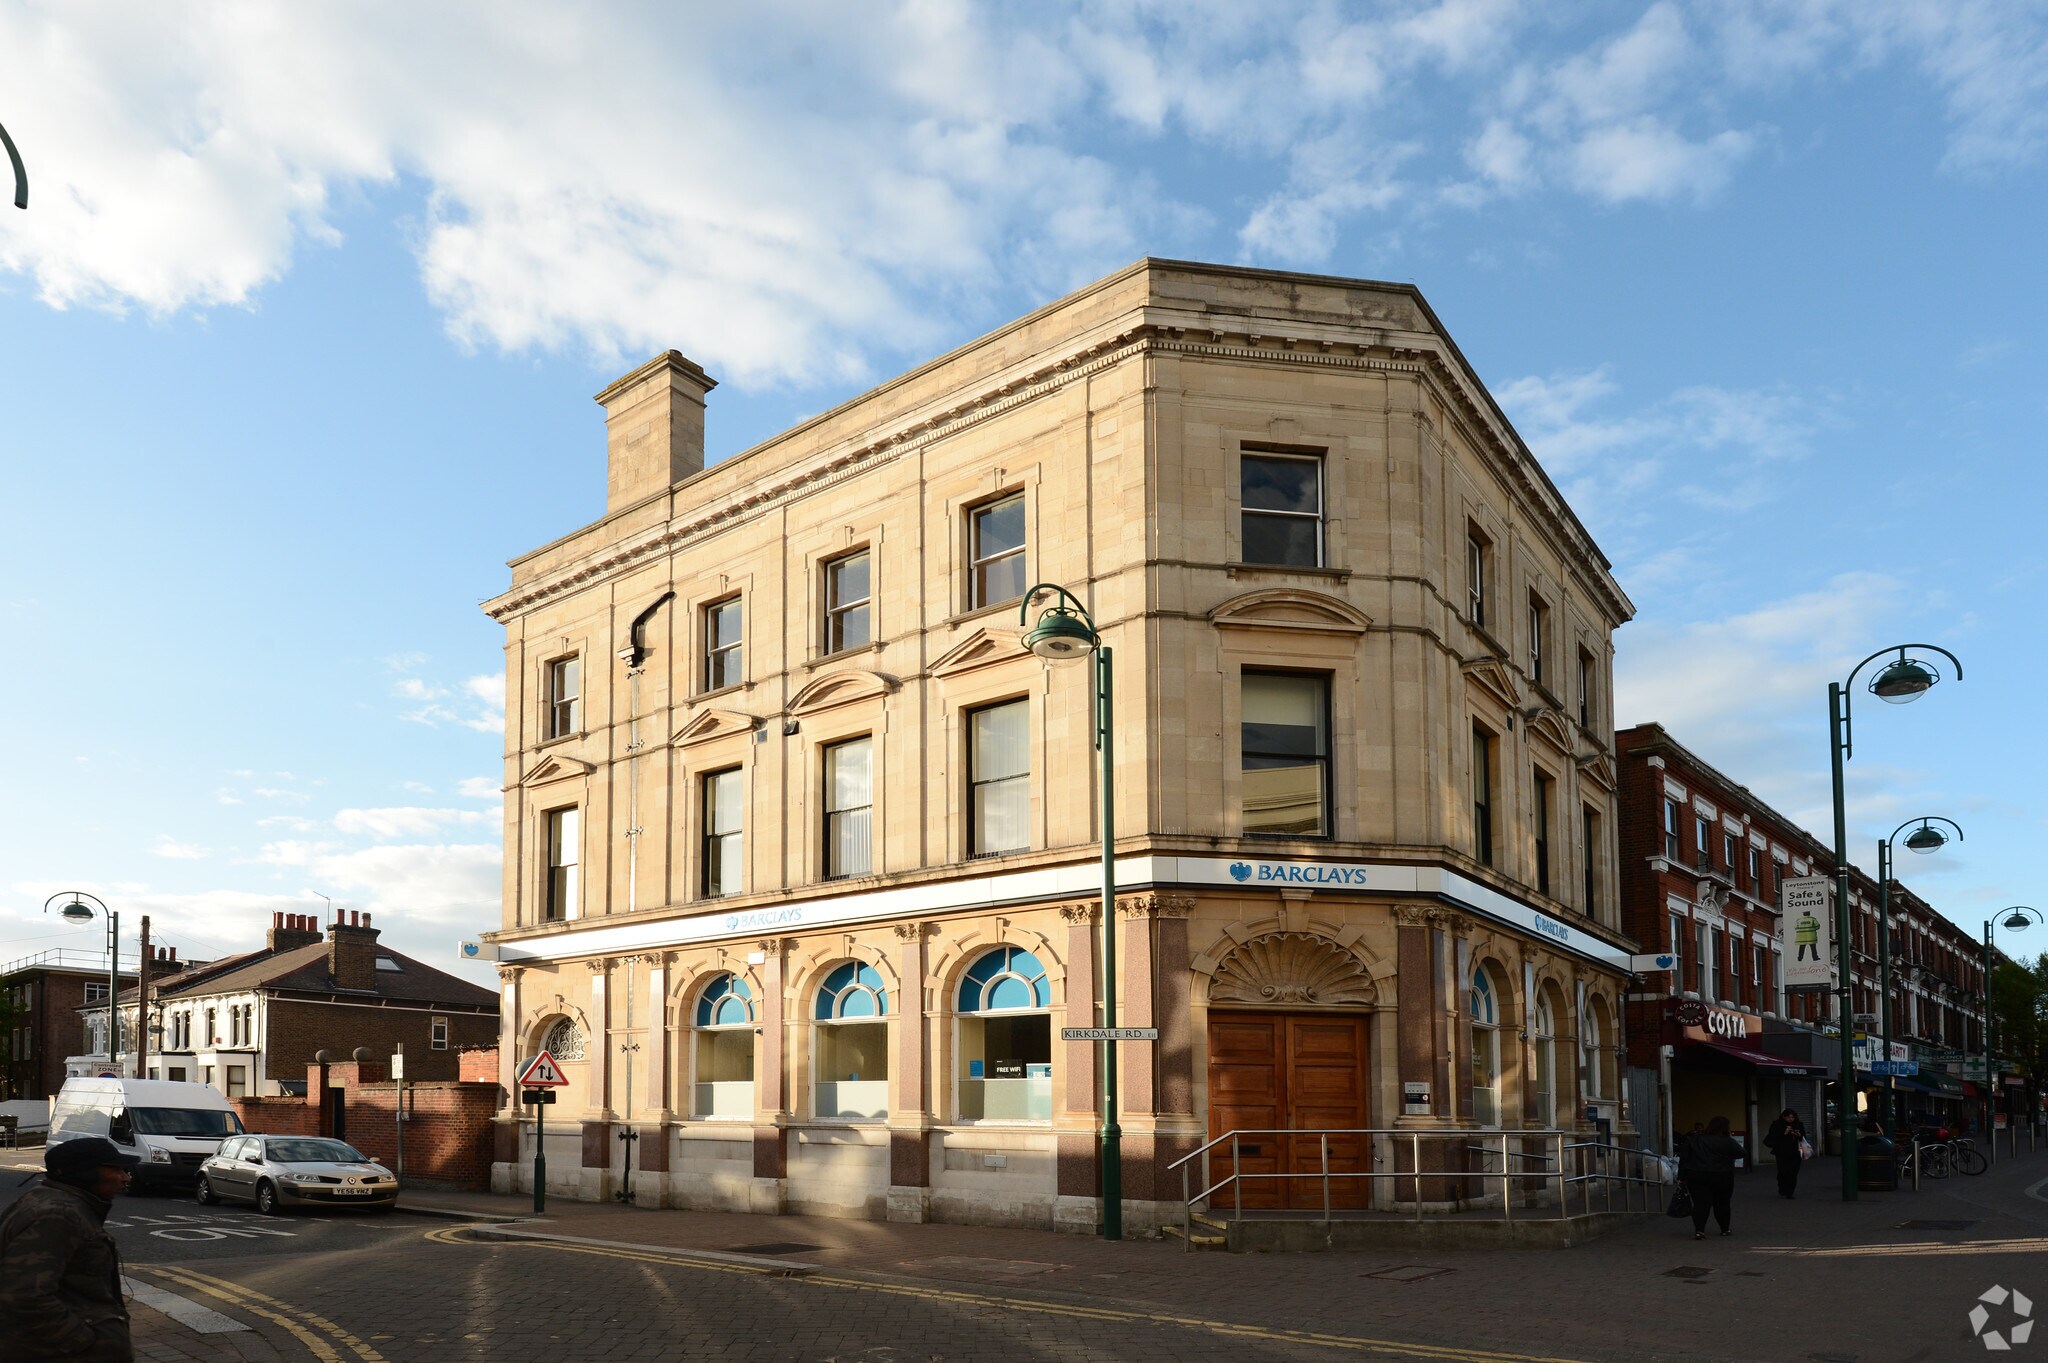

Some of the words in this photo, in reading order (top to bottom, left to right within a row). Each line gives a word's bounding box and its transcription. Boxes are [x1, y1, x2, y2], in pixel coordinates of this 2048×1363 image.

[1257, 864, 1367, 885] BARCLAYS
[1789, 890, 1813, 899] Safe
[1787, 897, 1824, 908] Sound
[740, 908, 802, 927] BARCLAYS
[1541, 919, 1569, 941] BARCLAYS
[1679, 1003, 1701, 1011] COSTA
[1677, 1015, 1703, 1024] COFFEE
[1708, 1010, 1747, 1040] COSTA
[1064, 1030, 1121, 1038] KIRKDALE
